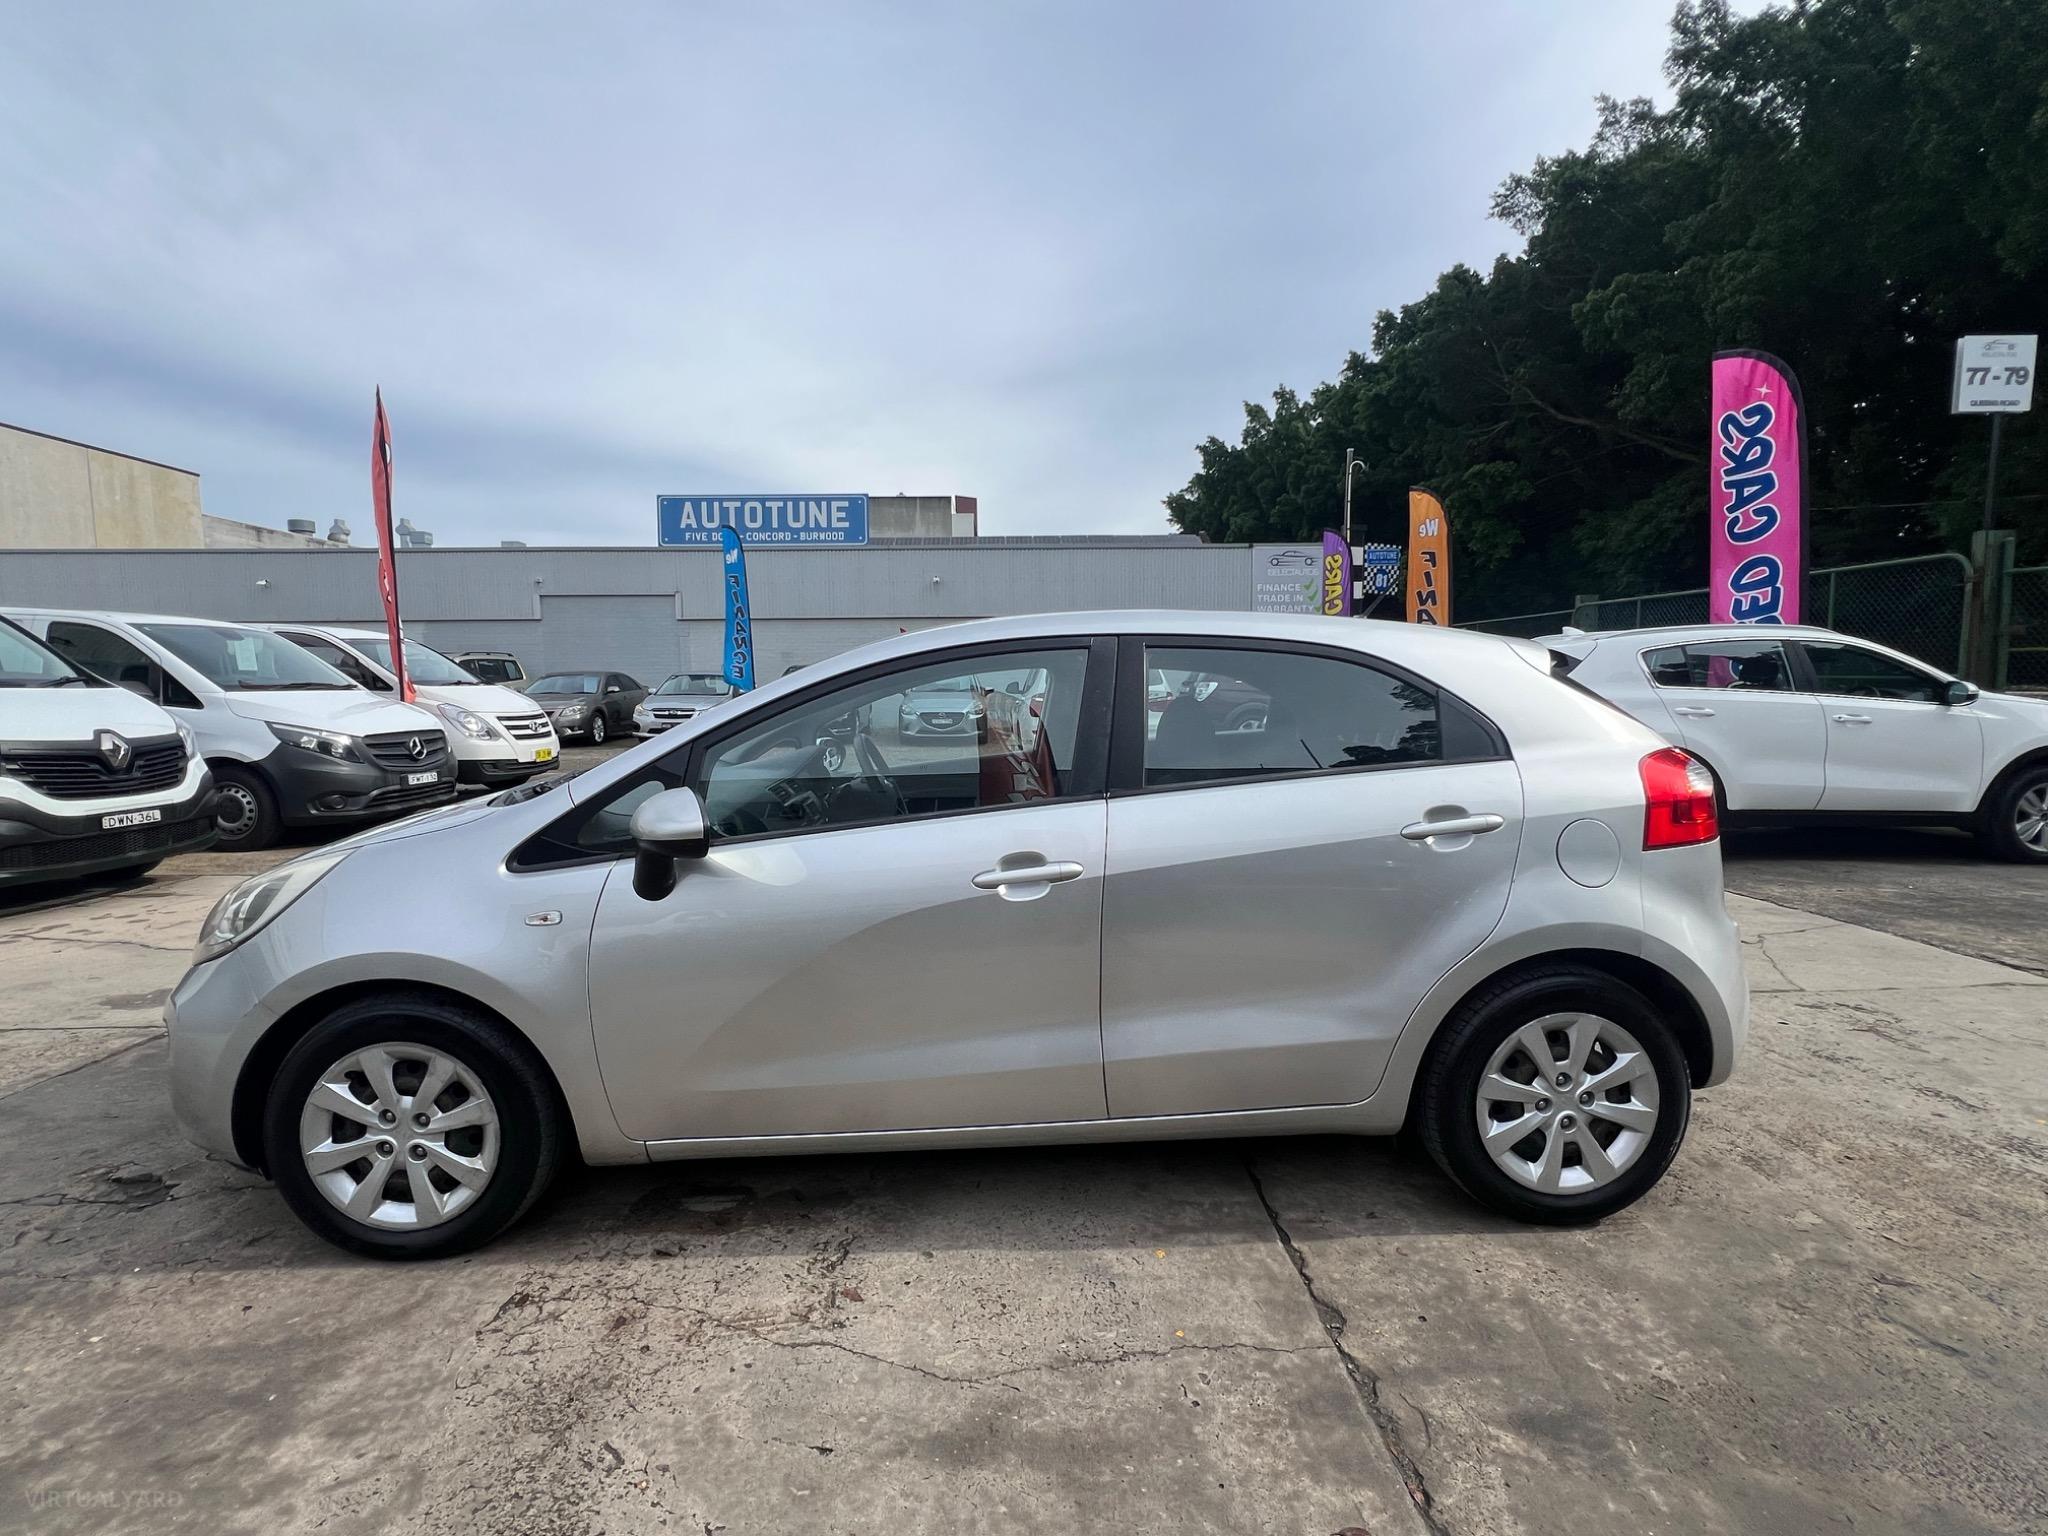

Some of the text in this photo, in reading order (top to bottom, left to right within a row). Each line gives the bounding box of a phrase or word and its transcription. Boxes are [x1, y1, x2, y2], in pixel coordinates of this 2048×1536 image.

[680, 501, 850, 529] AUTOTUNE
[685, 532, 708, 541] FIVE
[746, 532, 791, 540] CONCORD
[800, 532, 845, 540] BURWOOD
[1257, 583, 1301, 592] FINANCE
[1257, 594, 1304, 602] TRADE IN
[1256, 605, 1314, 613] WARRANTY
